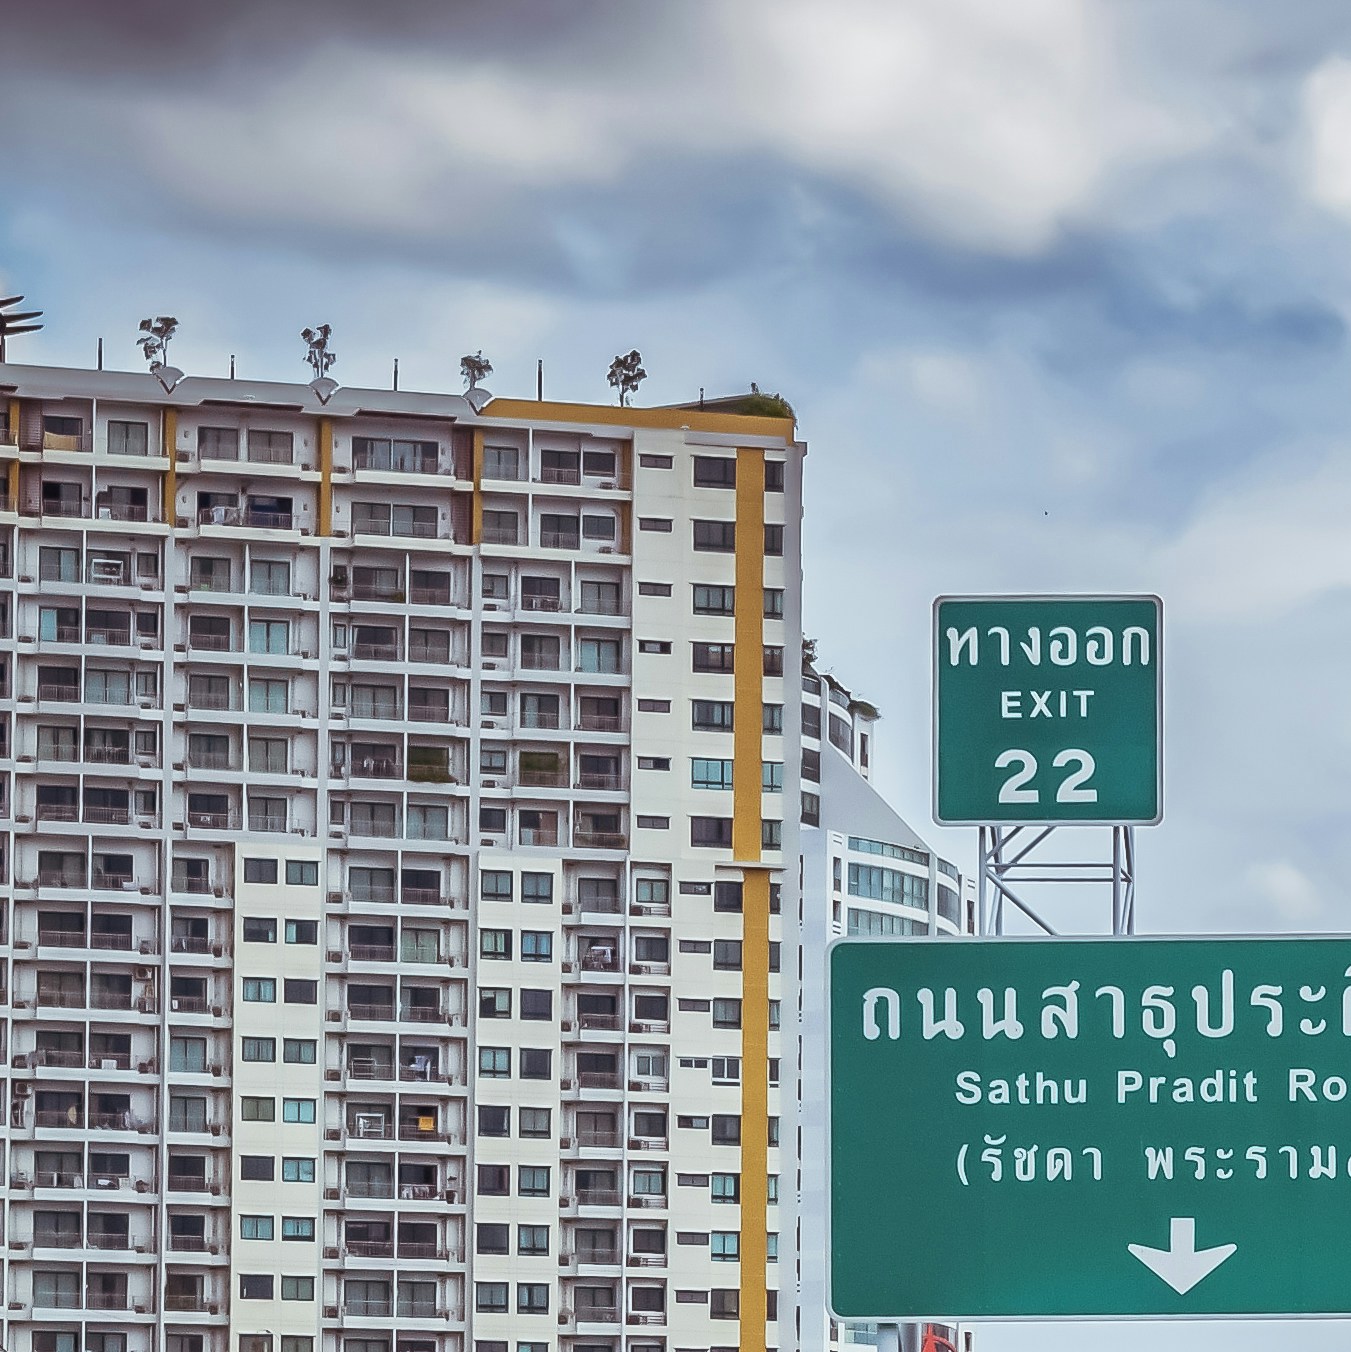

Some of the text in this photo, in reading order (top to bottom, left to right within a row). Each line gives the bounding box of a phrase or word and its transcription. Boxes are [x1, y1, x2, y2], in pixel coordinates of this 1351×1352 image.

[946, 626, 1150, 667] ทางออก
[1001, 690, 1095, 718] EXIT
[994, 748, 1098, 804] 22
[955, 1071, 1087, 1105] Sathu
[1117, 1069, 1258, 1103] Pradit
[957, 1134, 1103, 1187] (รัชดา
